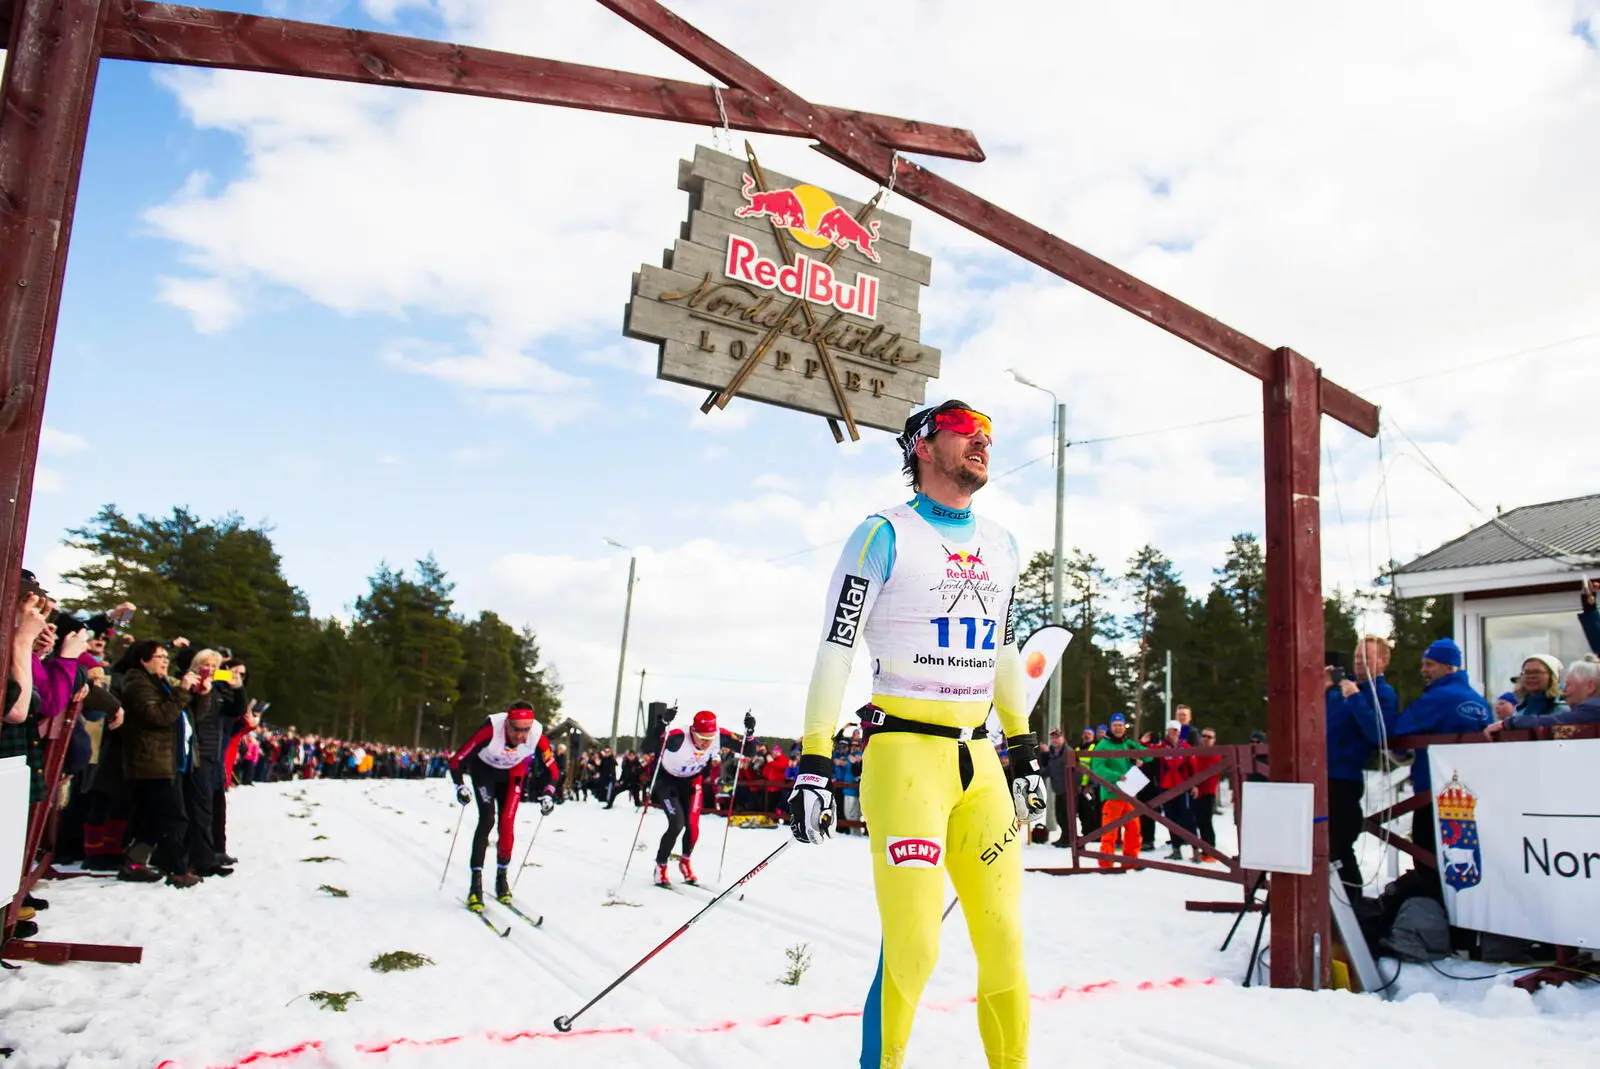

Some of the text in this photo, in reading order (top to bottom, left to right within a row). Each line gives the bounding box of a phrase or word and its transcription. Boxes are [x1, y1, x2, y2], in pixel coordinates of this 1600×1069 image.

[700, 330, 885, 398] LOPPET
[942, 594, 995, 603] LOPPET
[930, 616, 997, 650] 112
[913, 653, 944, 666] John
[948, 655, 988, 668] Kristian
[953, 686, 971, 696] april
[894, 843, 938, 859] MENY
[1523, 836, 1600, 879] Nor
